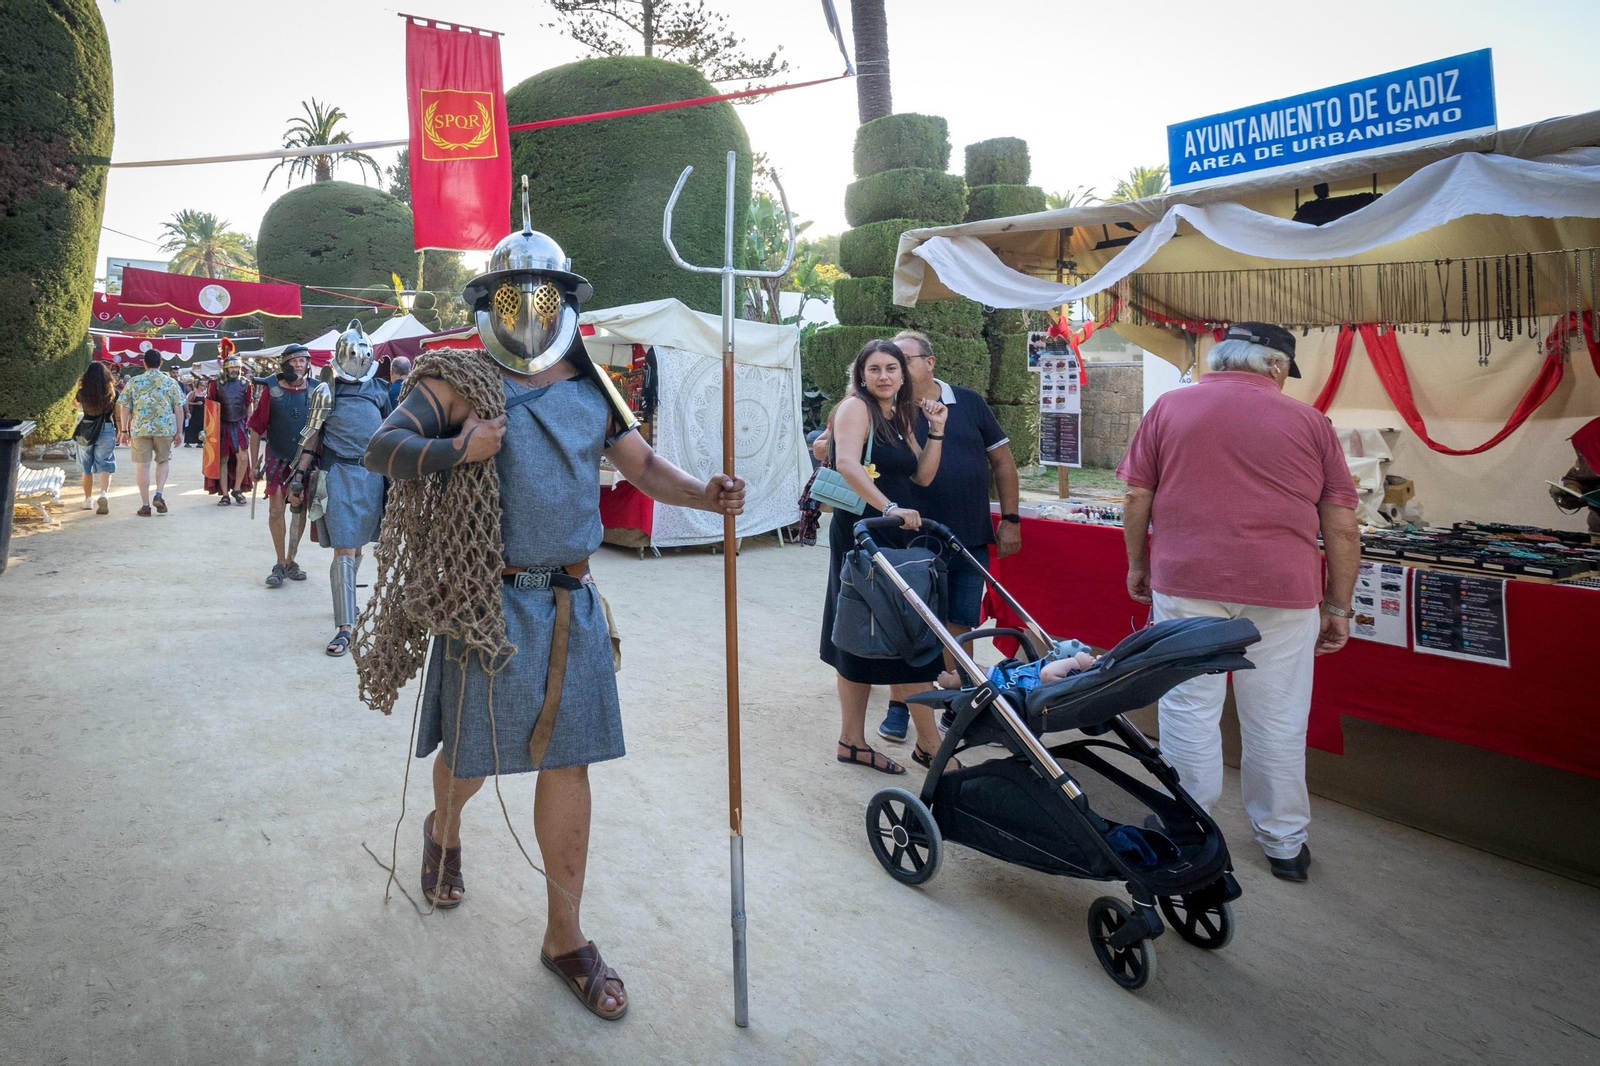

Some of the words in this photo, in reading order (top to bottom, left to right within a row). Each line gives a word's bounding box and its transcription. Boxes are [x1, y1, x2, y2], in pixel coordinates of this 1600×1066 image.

[435, 114, 481, 130] SPQR
[1184, 97, 1342, 158] AYUNTAMIENTO
[1349, 88, 1380, 122] DE
[1386, 69, 1462, 115] CADIZ
[1188, 152, 1247, 174] AREA
[1255, 144, 1285, 162] DE
[1292, 107, 1463, 154] URBANISMO
